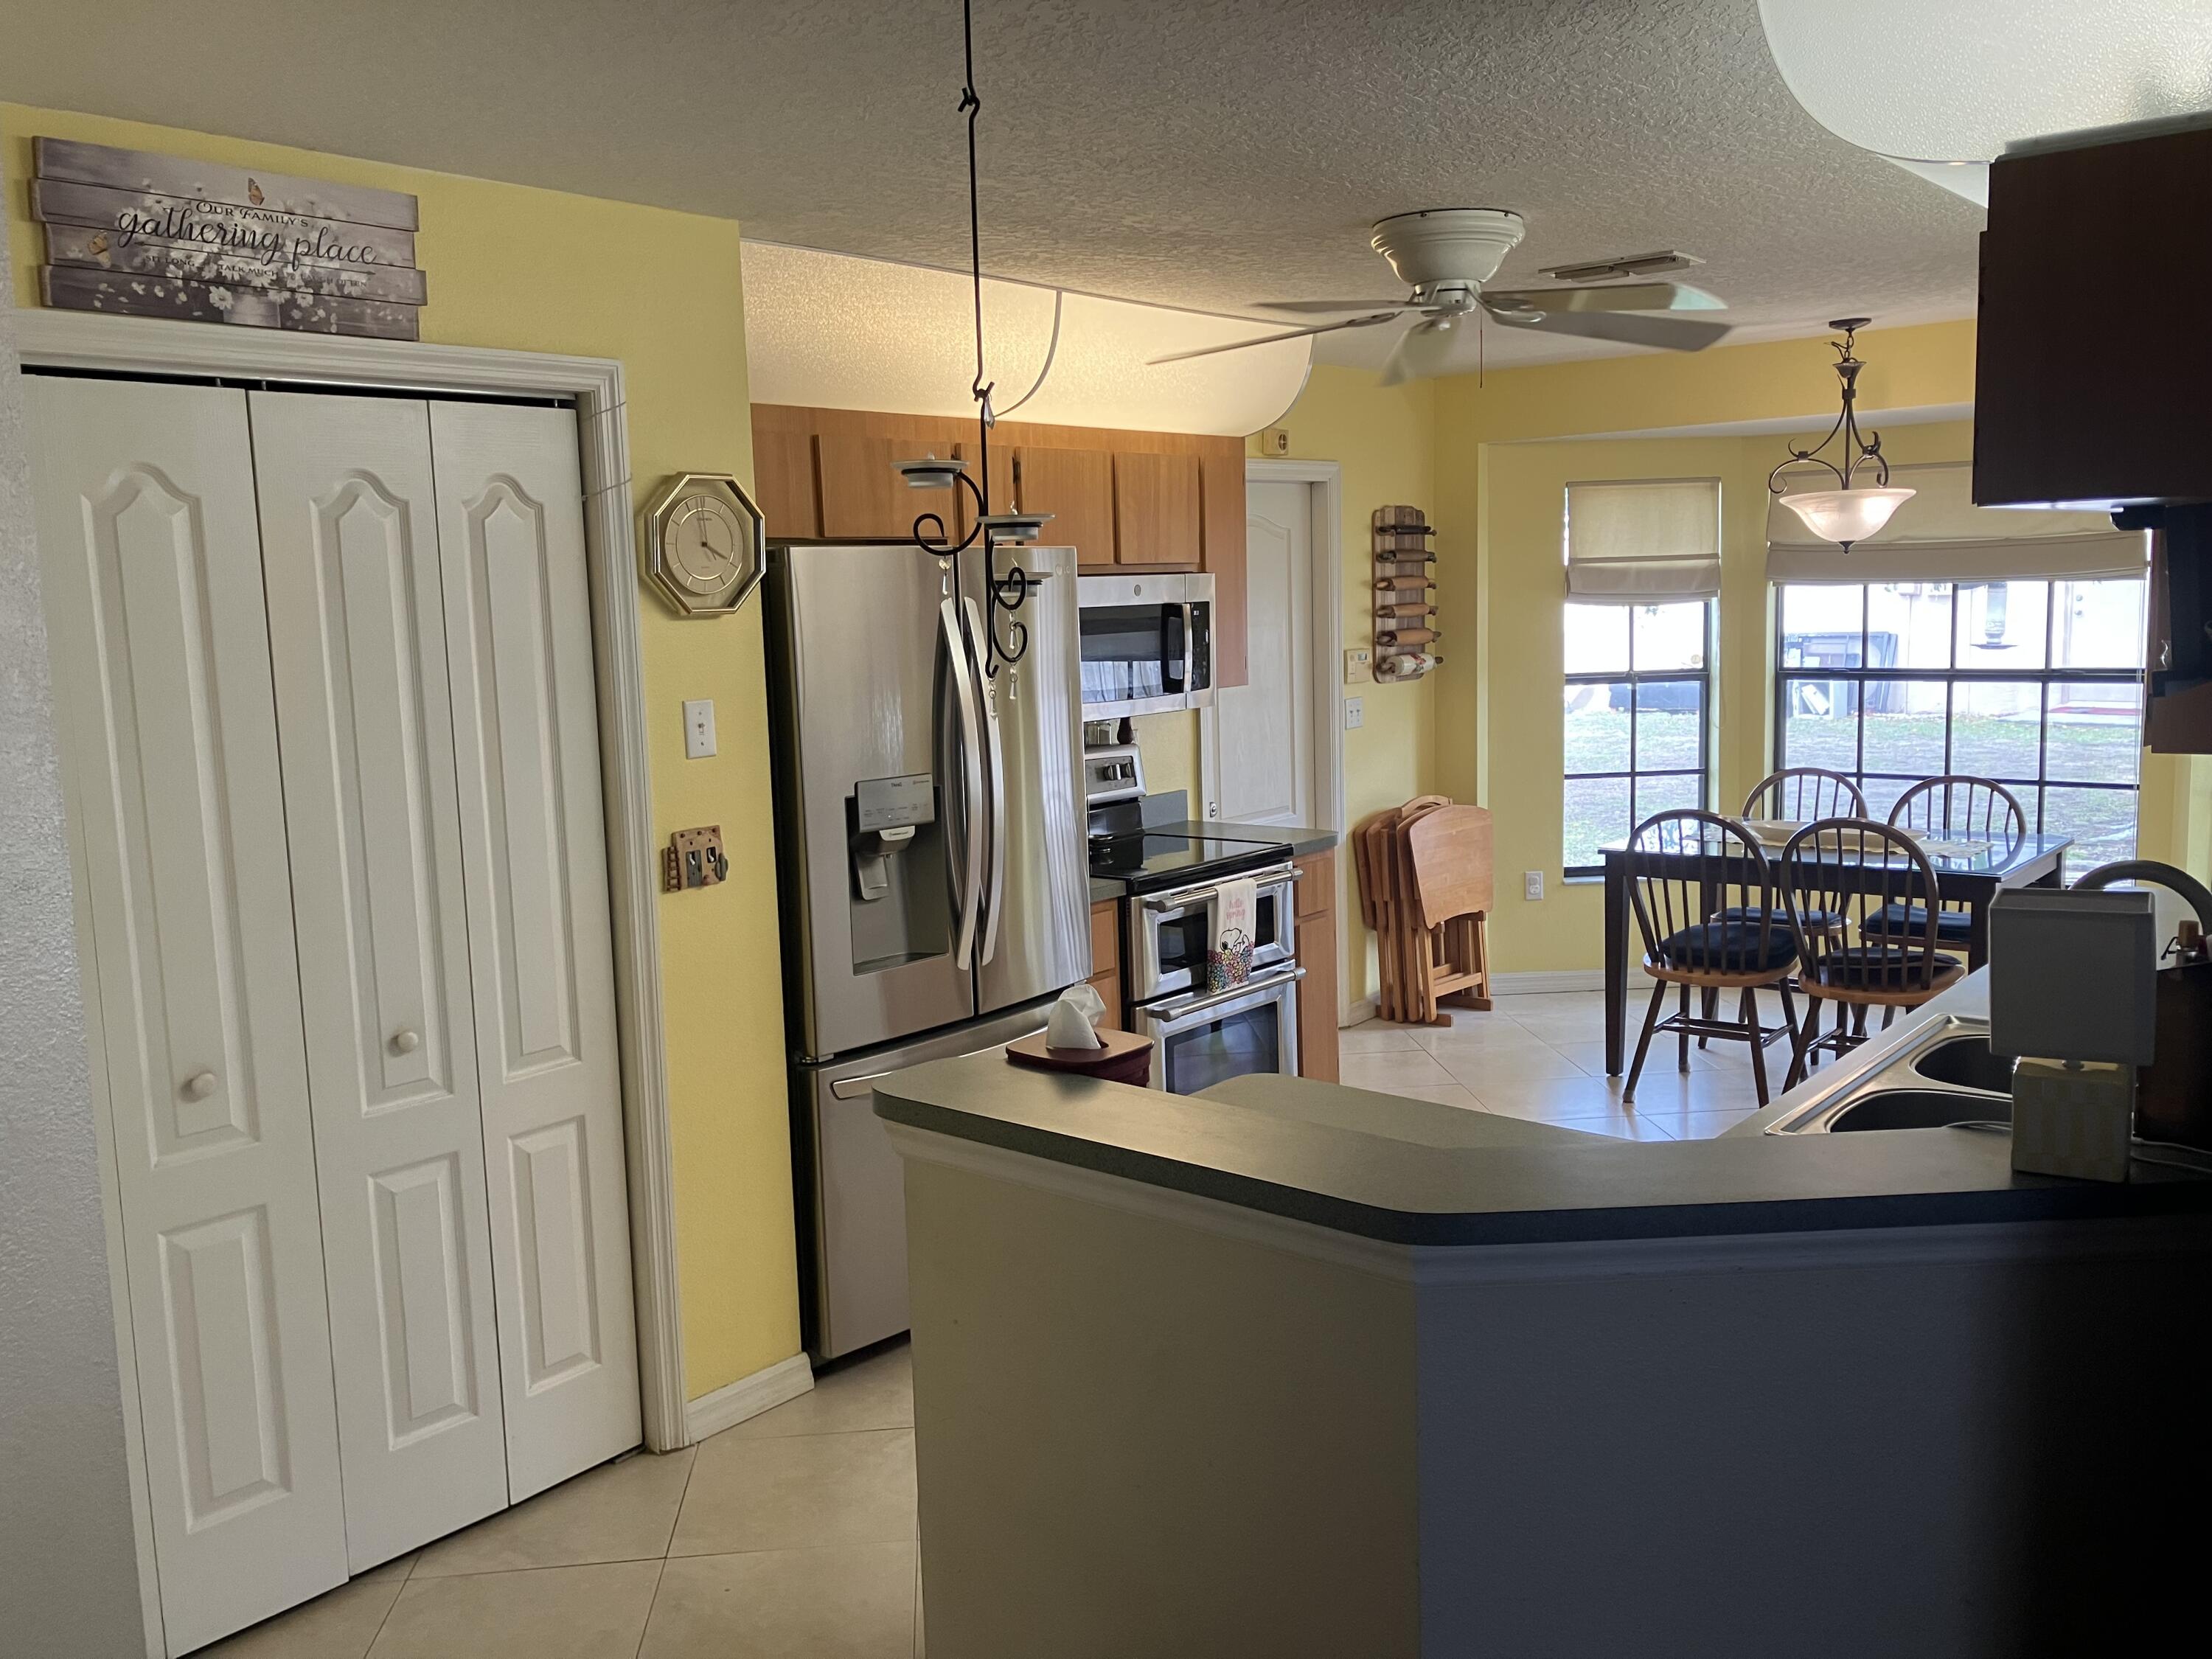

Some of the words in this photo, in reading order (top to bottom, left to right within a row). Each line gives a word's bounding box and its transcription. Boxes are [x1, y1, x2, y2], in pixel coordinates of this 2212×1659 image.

[118, 206, 283, 266] gathering
[291, 226, 378, 271] place
[145, 255, 161, 263] SIT
[165, 257, 195, 268] LONG
[219, 264, 246, 273] TALK
[248, 267, 279, 277] MUCH
